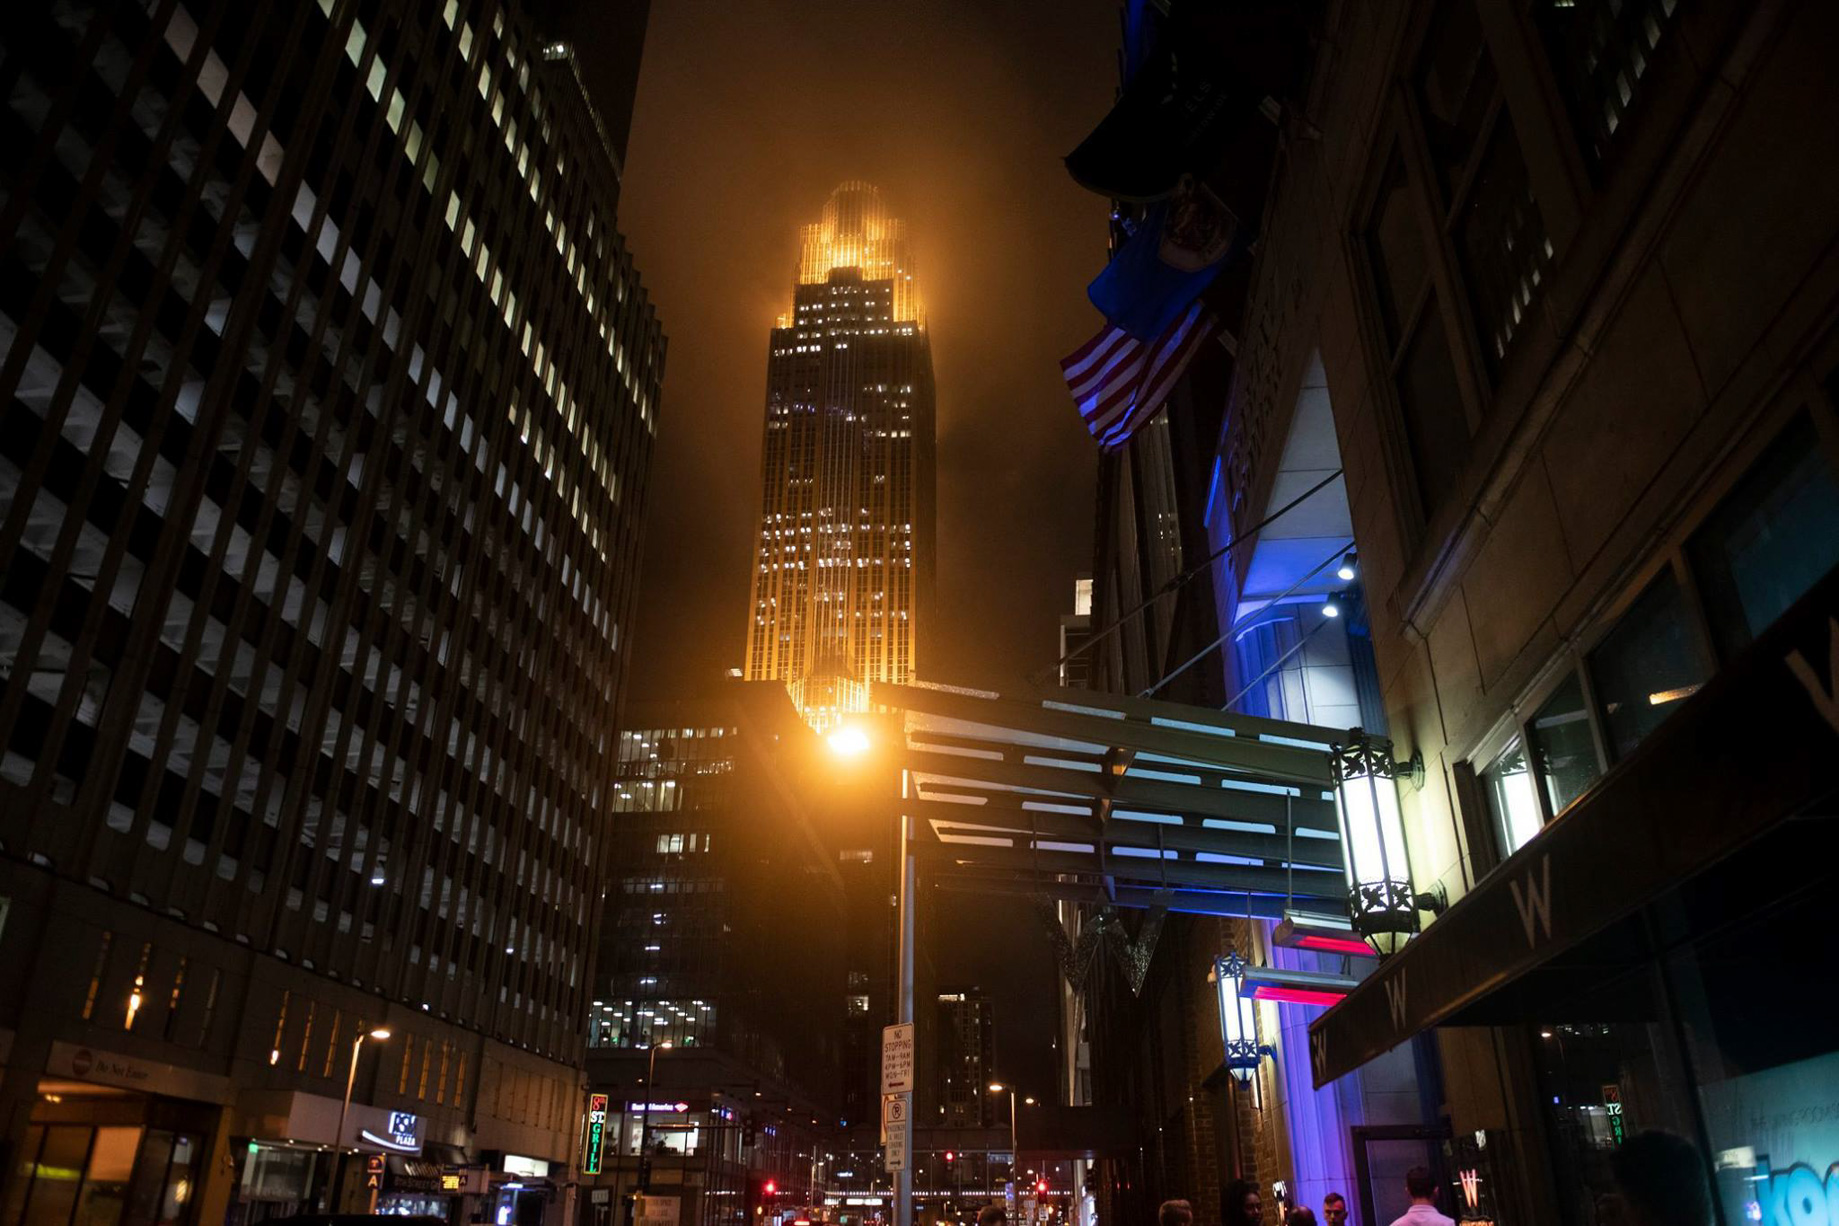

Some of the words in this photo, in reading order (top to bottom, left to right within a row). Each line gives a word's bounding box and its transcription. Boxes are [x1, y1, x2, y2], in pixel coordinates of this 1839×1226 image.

[1508, 853, 1552, 950] W
[1383, 968, 1408, 1031] W
[885, 1039, 911, 1053] STOPPING
[893, 1029, 903, 1041] NO
[1312, 1027, 1328, 1079] W
[396, 1135, 416, 1146] PLAZA
[589, 1123, 602, 1173] GRILL
[368, 1175, 378, 1187] A
[1459, 1168, 1478, 1208] W
